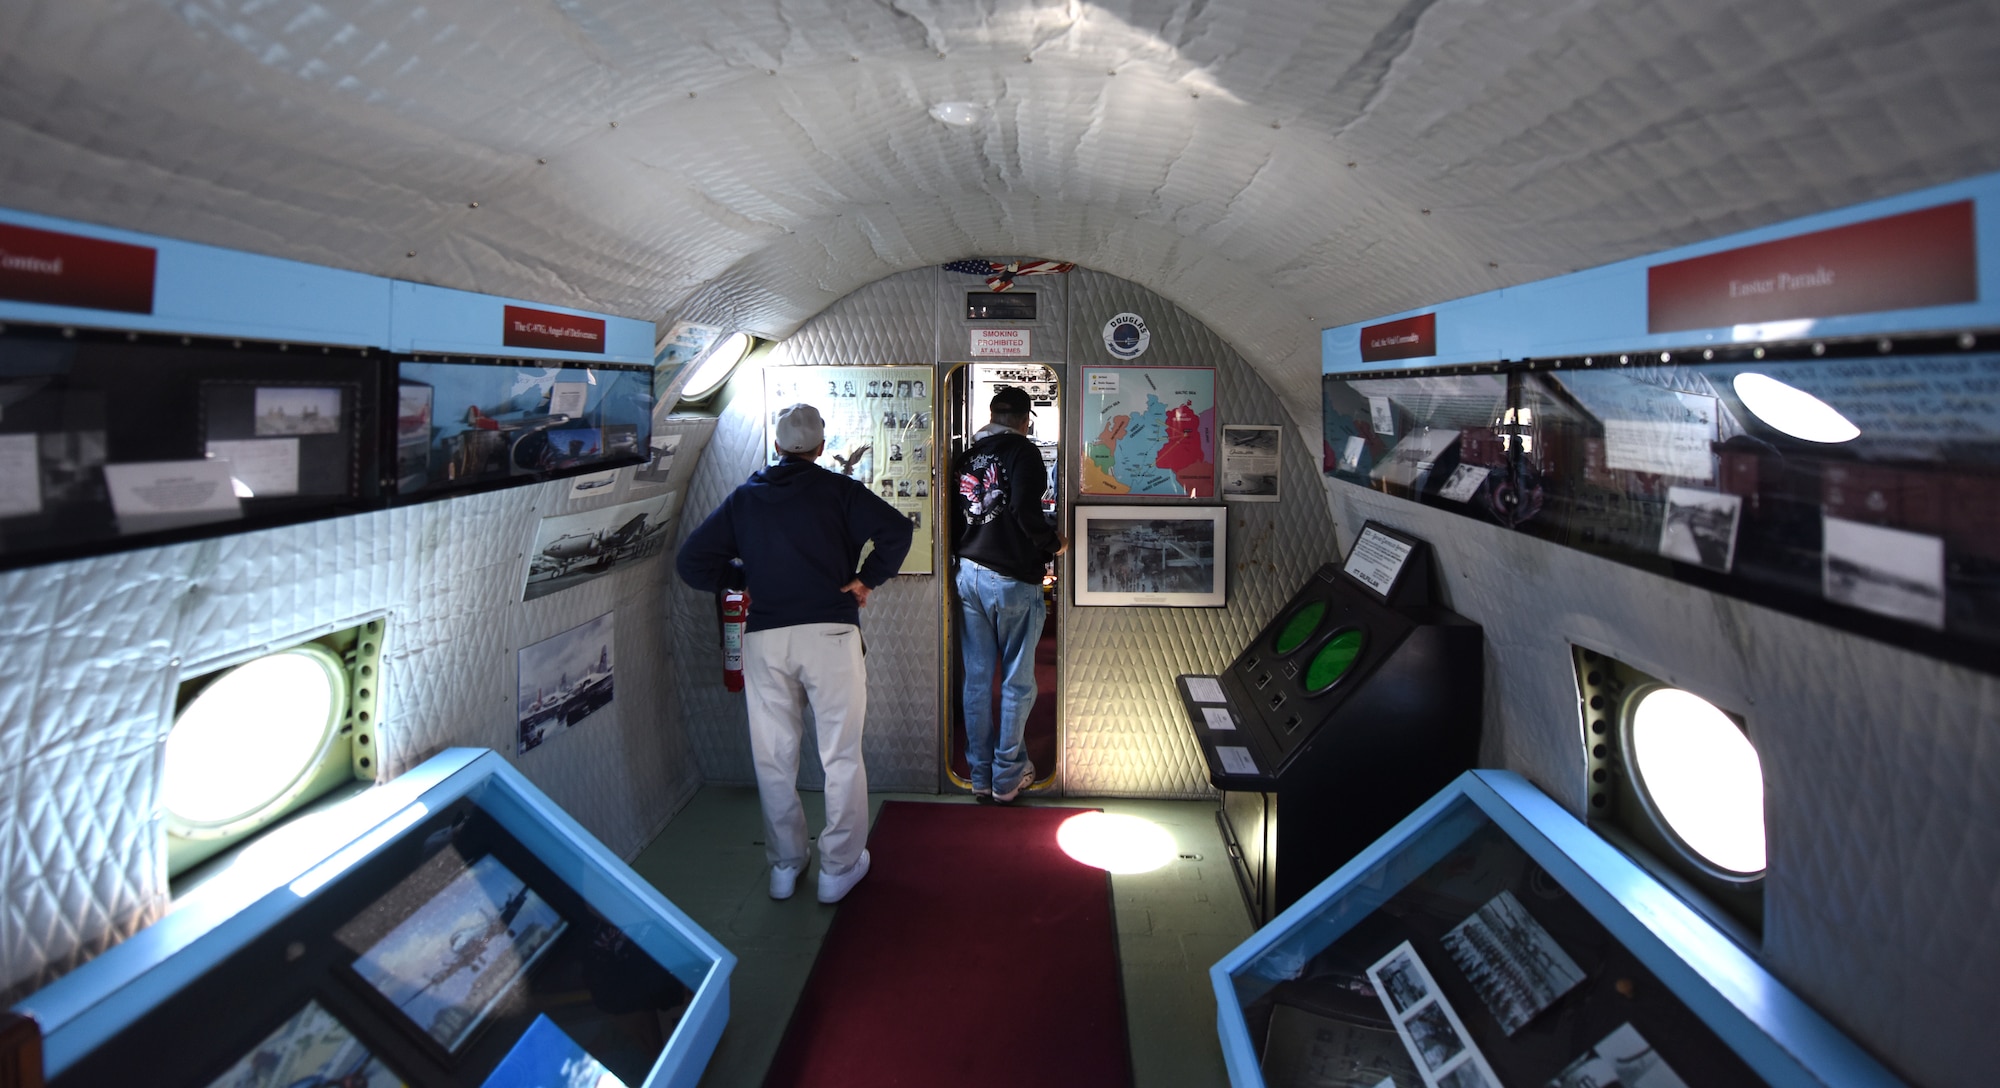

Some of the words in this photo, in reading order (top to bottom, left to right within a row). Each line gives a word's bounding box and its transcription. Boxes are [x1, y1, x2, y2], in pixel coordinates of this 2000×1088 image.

[1728, 277, 1774, 298] Easter
[1777, 266, 1836, 292] Parade
[513, 321, 526, 332] The
[1110, 316, 1148, 333] DOUGLAS
[982, 330, 1018, 338] SMOKING
[977, 339, 1024, 347] PROHIBITED
